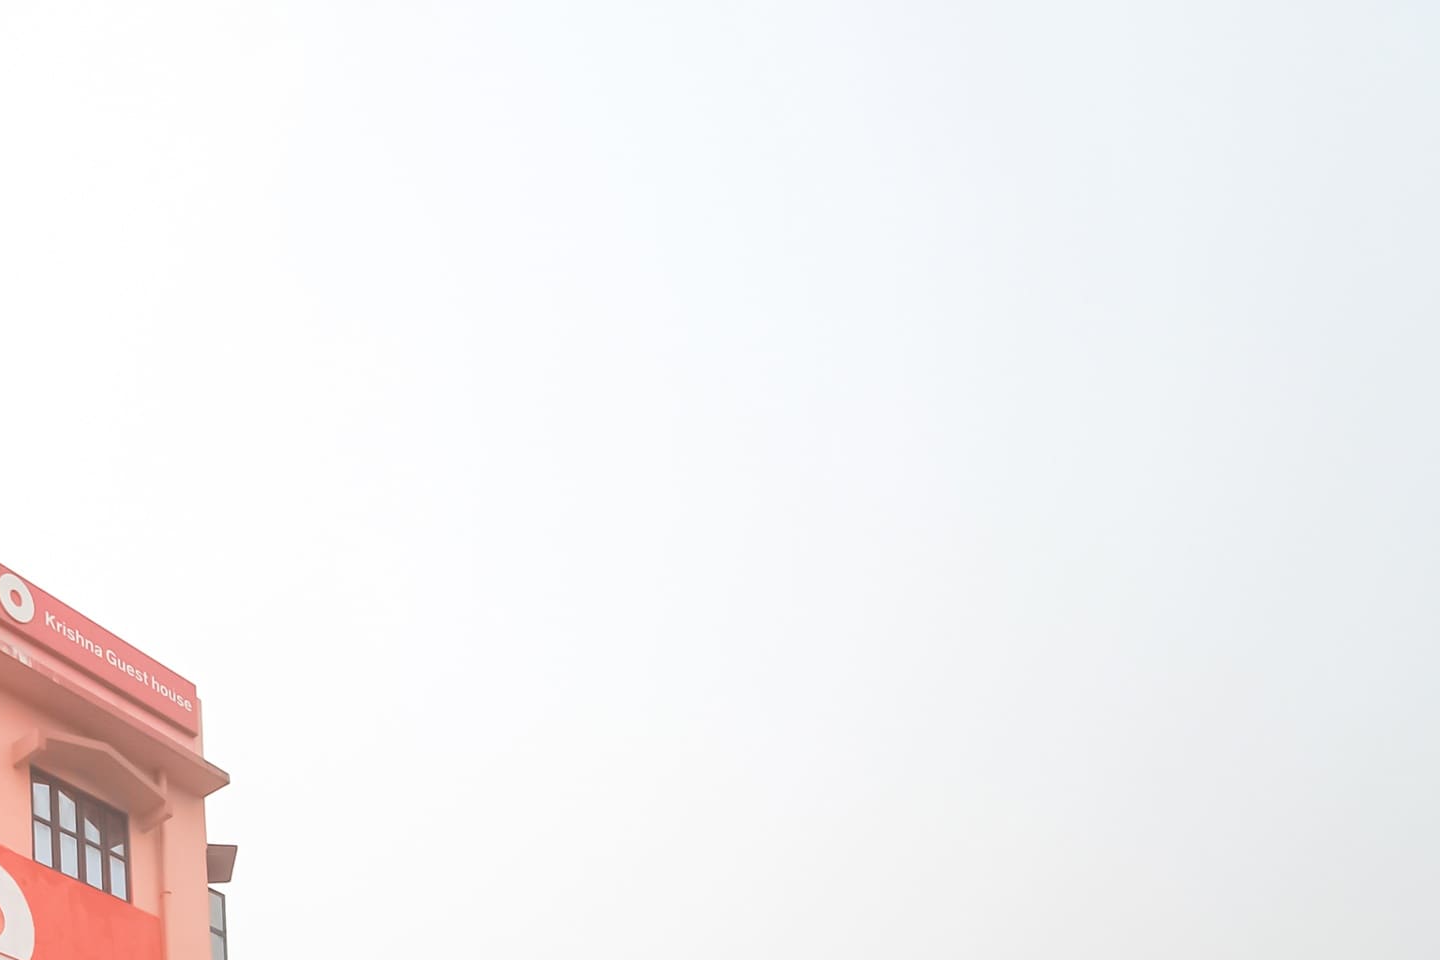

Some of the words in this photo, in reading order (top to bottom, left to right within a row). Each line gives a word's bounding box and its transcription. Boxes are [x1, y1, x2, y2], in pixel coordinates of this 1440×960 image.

[45, 611, 103, 658] Krishna
[105, 649, 149, 686] Guest
[151, 675, 193, 712] house
